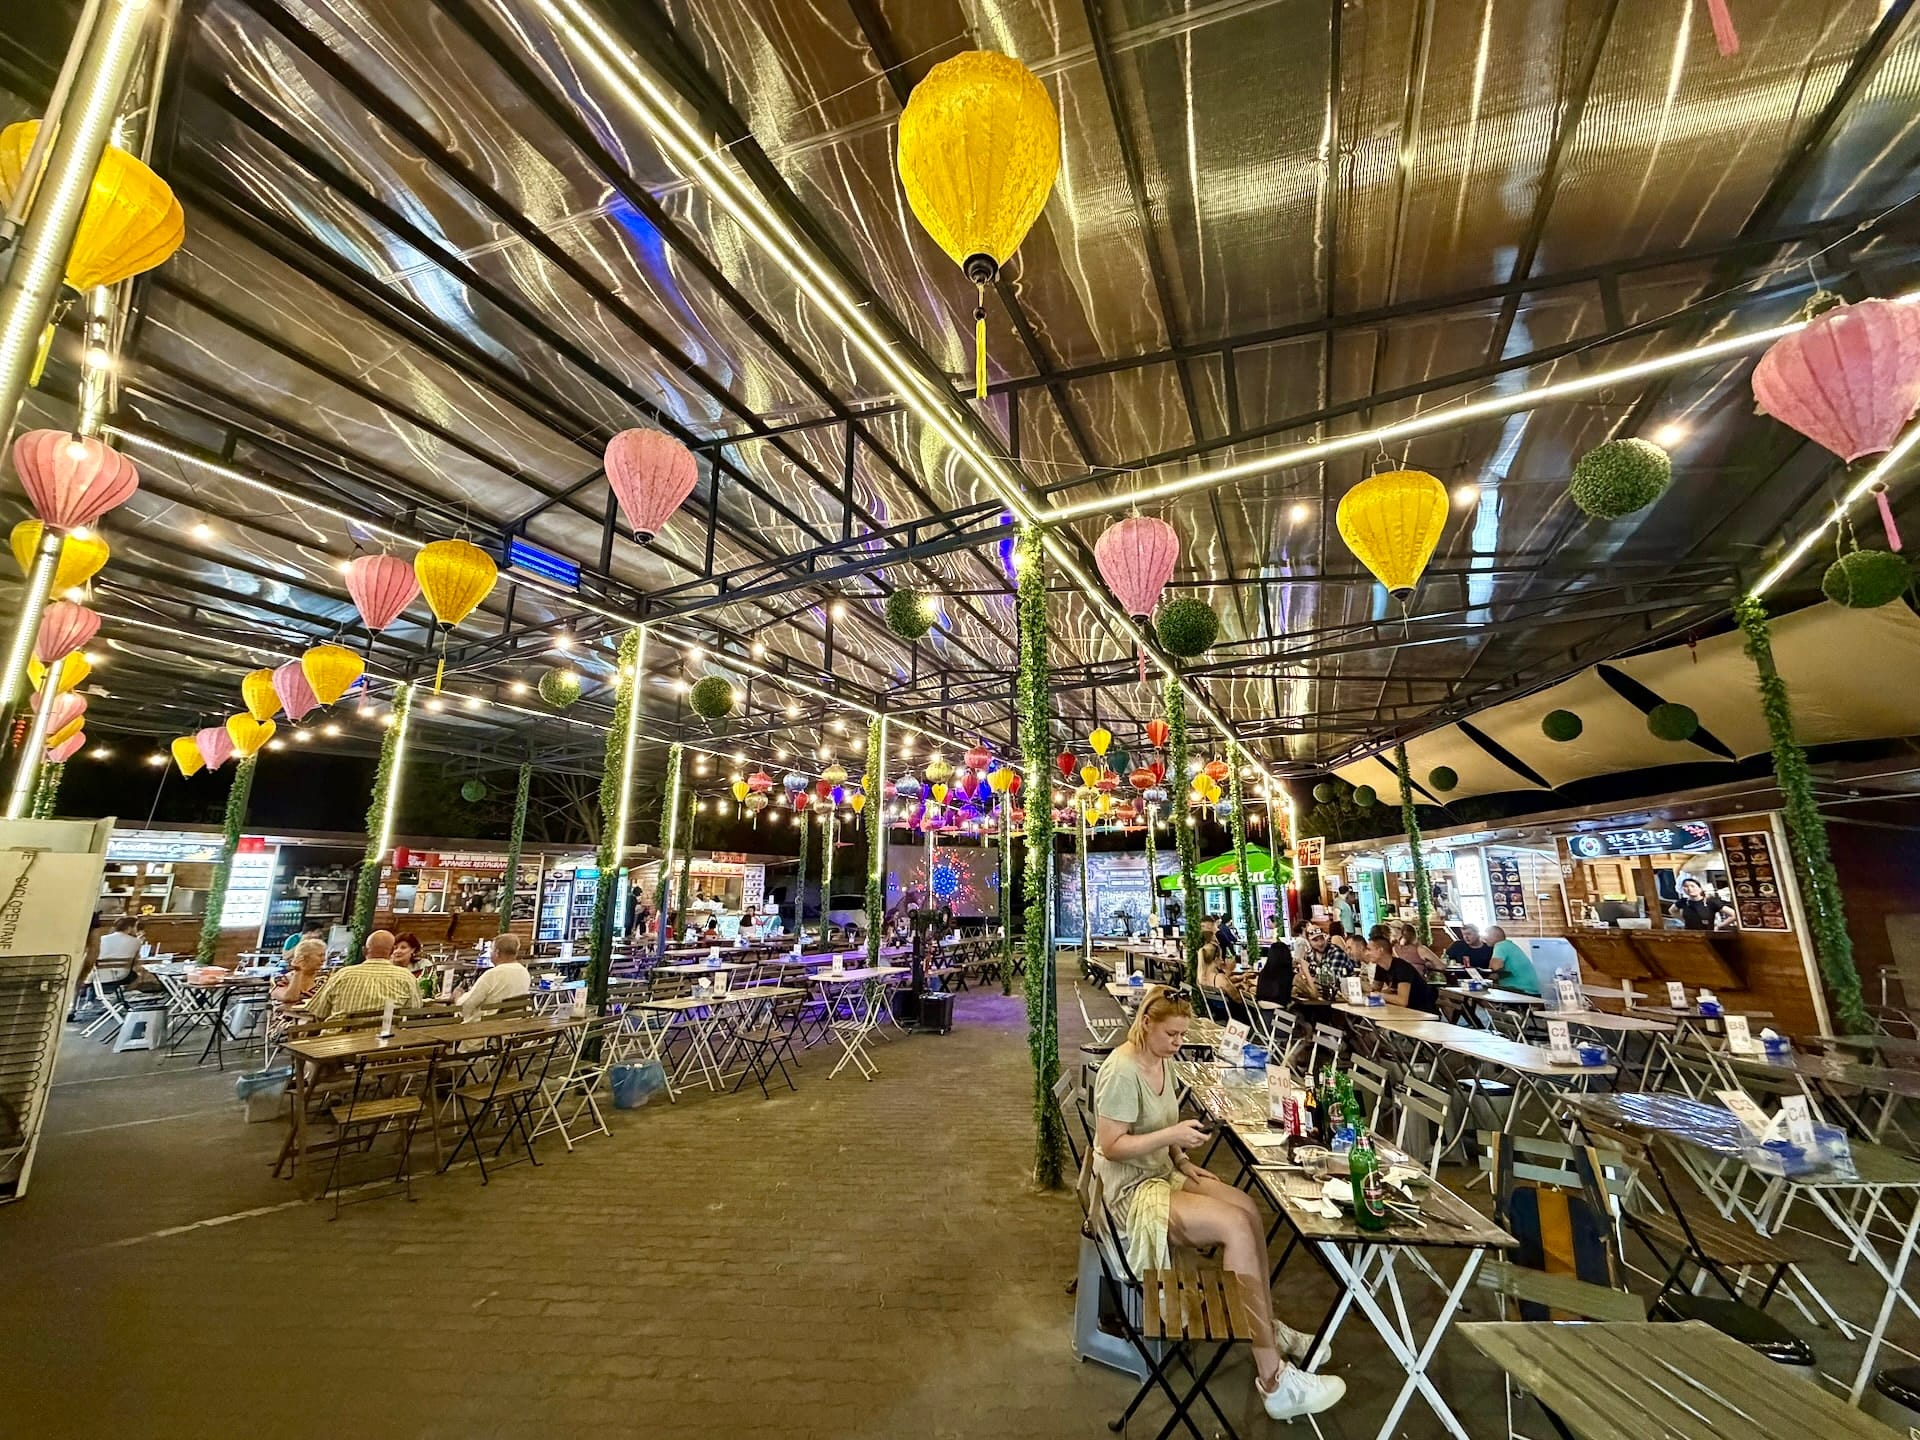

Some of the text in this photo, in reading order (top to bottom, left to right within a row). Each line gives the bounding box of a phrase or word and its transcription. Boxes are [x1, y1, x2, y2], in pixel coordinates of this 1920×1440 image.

[1606, 829, 1674, 847] 한국식당
[472, 860, 508, 868] RESTAURAN
[1176, 871, 1266, 887] Hineken
[0, 877, 29, 950] CYCLOPENTANE
[1228, 1025, 1245, 1039] D4
[1551, 1027, 1567, 1038] C2
[1268, 1074, 1290, 1089] C10
[1728, 1099, 1755, 1111] C3
[1788, 1107, 1807, 1121] C4
